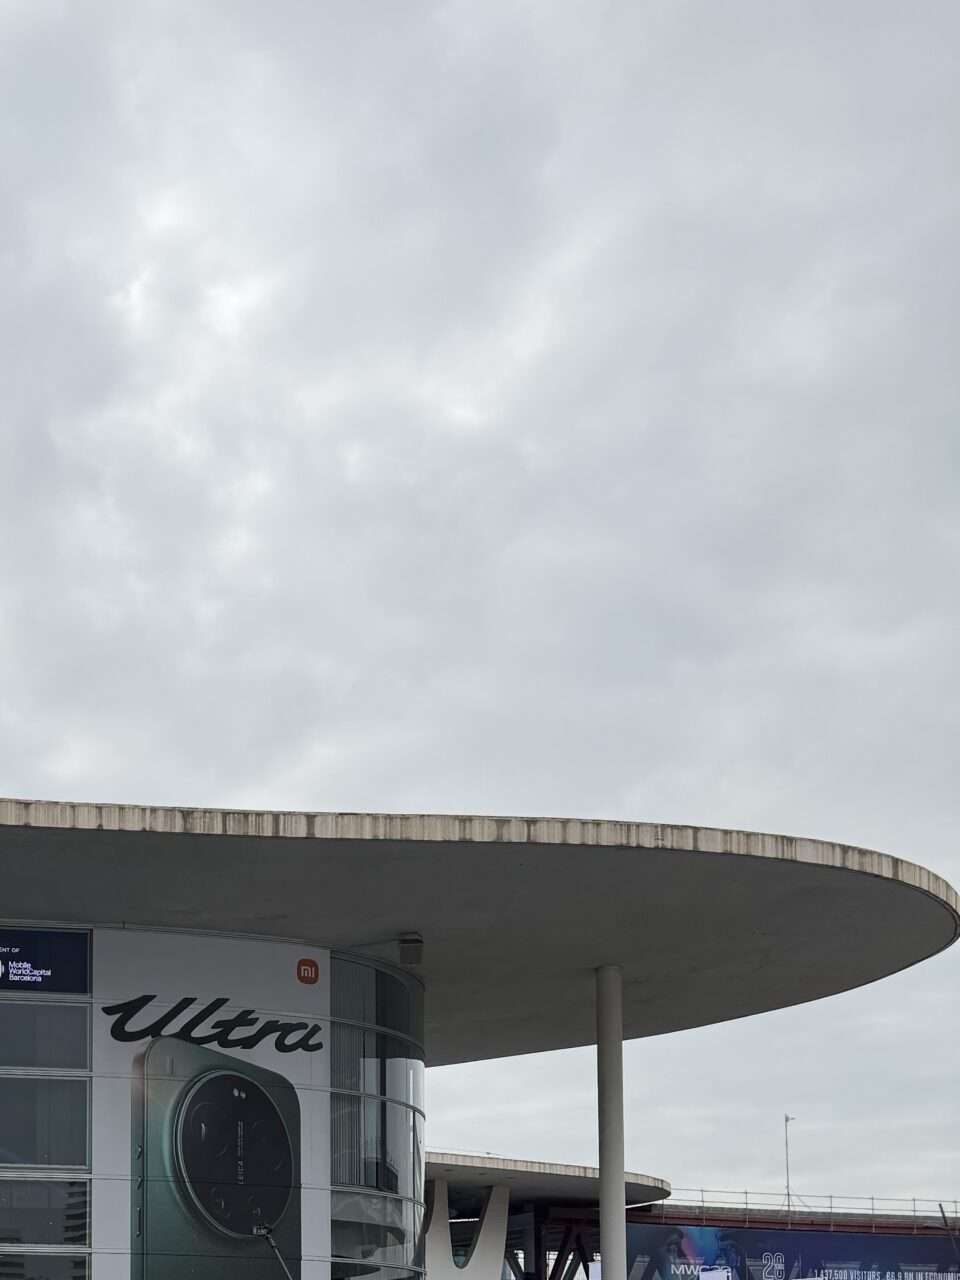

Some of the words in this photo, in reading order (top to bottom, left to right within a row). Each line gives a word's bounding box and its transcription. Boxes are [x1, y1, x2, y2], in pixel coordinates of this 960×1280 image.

[8, 961, 31, 969] Mobile
[9, 974, 42, 982] Barcelona
[101, 995, 324, 1053] Ultra
[849, 1270, 881, 1280] VISITORS
